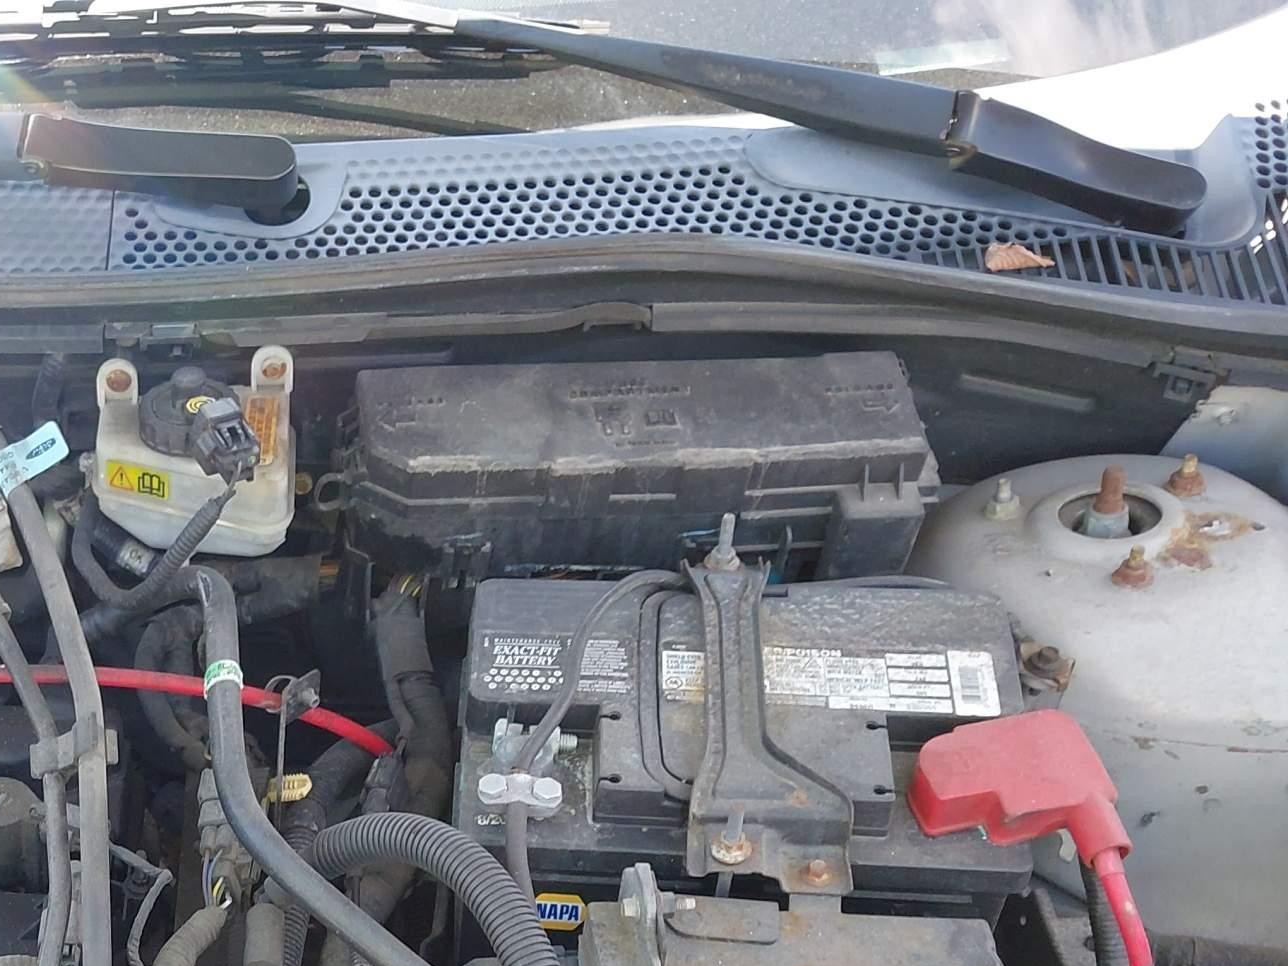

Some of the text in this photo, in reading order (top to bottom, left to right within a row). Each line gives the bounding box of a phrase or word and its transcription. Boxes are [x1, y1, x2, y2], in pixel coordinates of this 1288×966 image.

[493, 645, 561, 656] EXACT-FIT
[495, 654, 556, 666] BATTERY
[536, 902, 580, 921] NAPA
